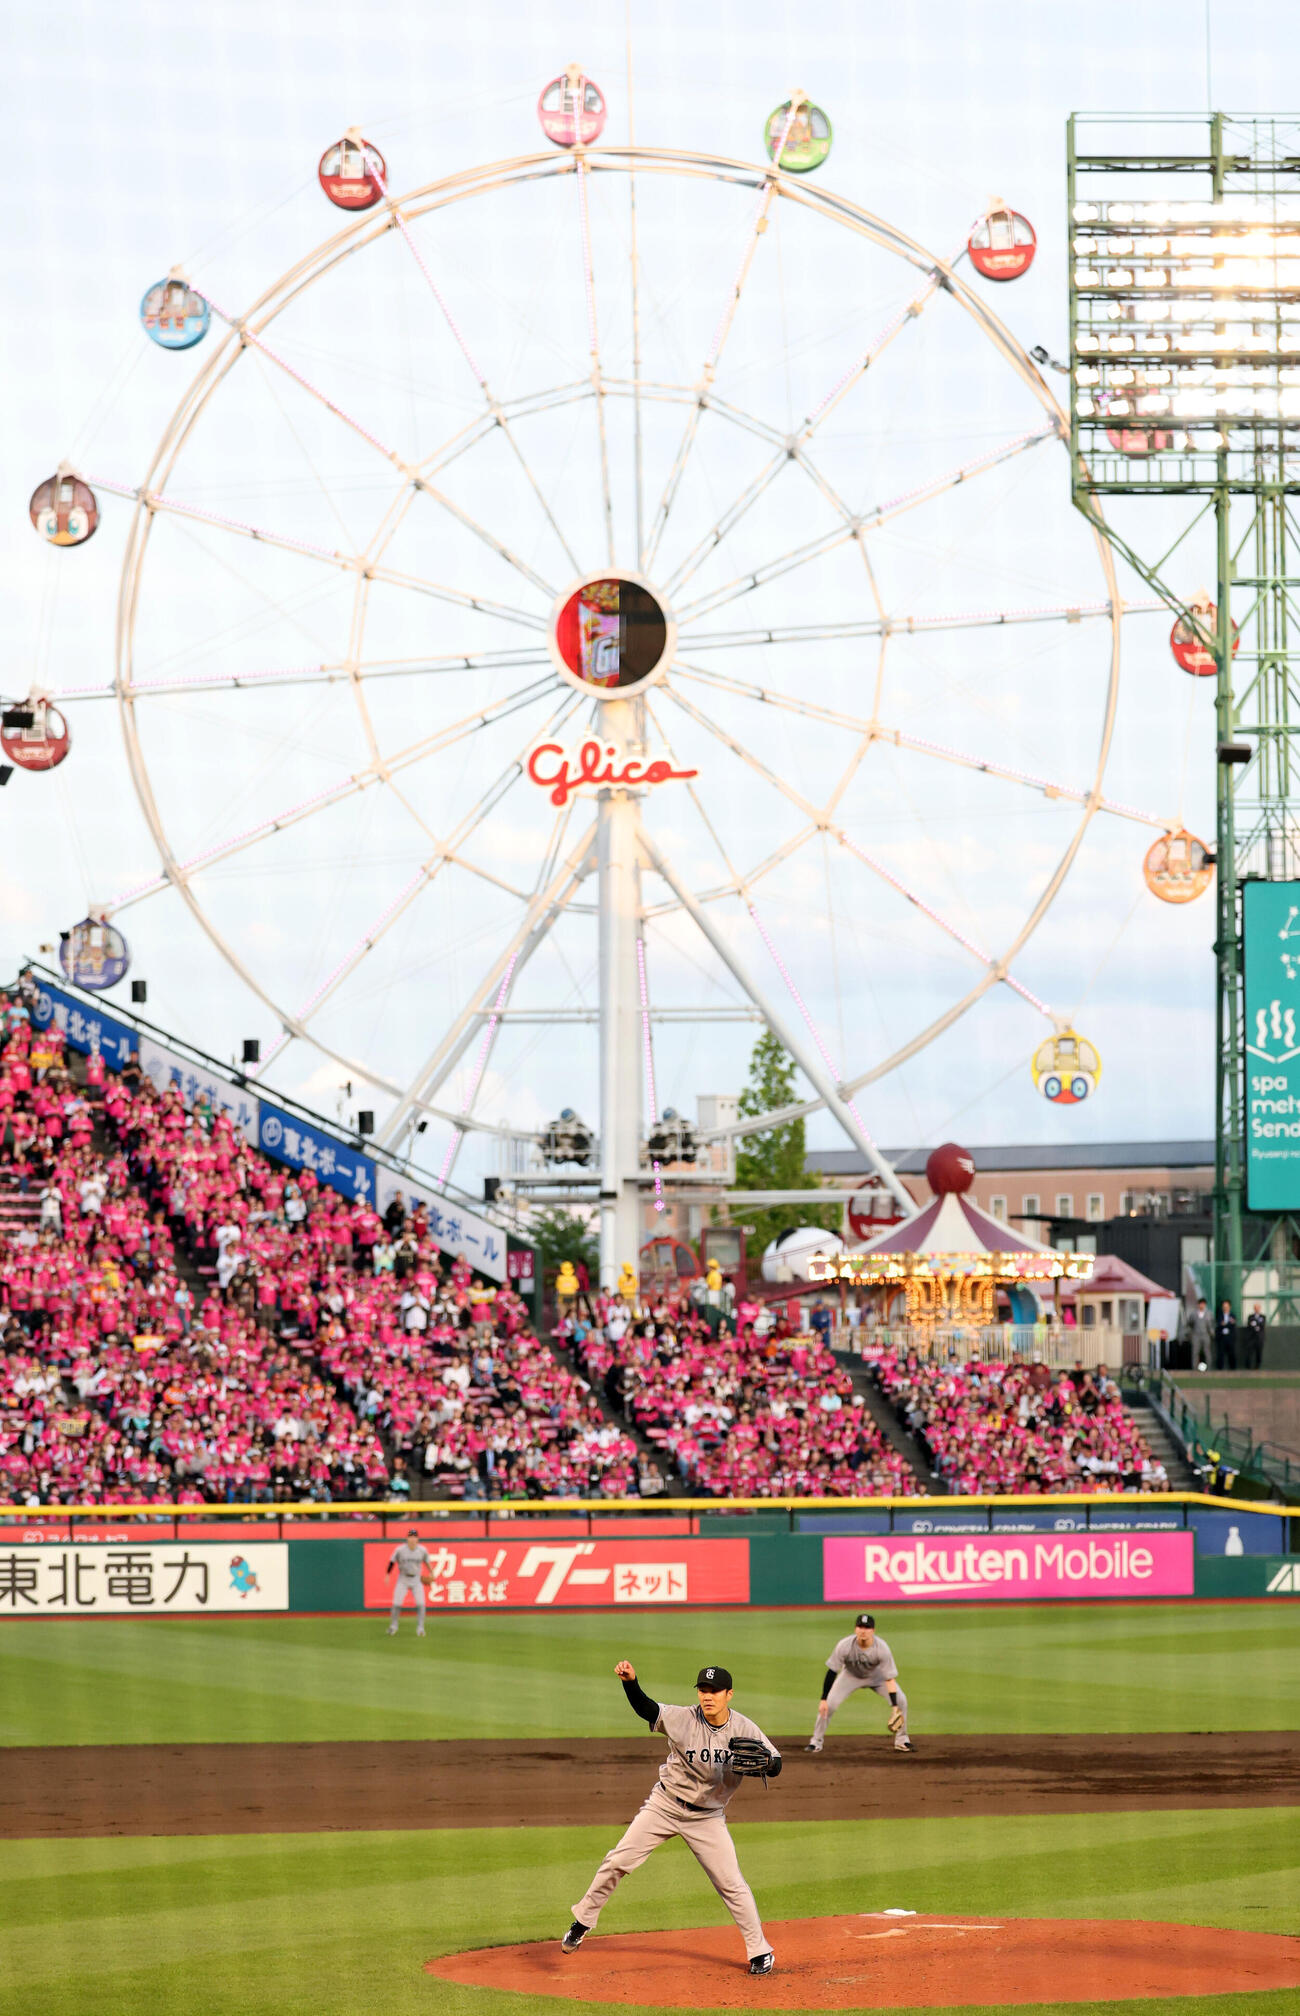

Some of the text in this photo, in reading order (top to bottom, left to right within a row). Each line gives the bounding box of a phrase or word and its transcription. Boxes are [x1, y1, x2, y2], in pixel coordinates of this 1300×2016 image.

[528, 741, 698, 806] Glico
[1251, 1076, 1288, 1096] spa
[0, 1552, 209, 1606] 東北電力
[864, 1540, 1153, 1583] Rakuten Mobile
[686, 1748, 734, 1765] TOKY
